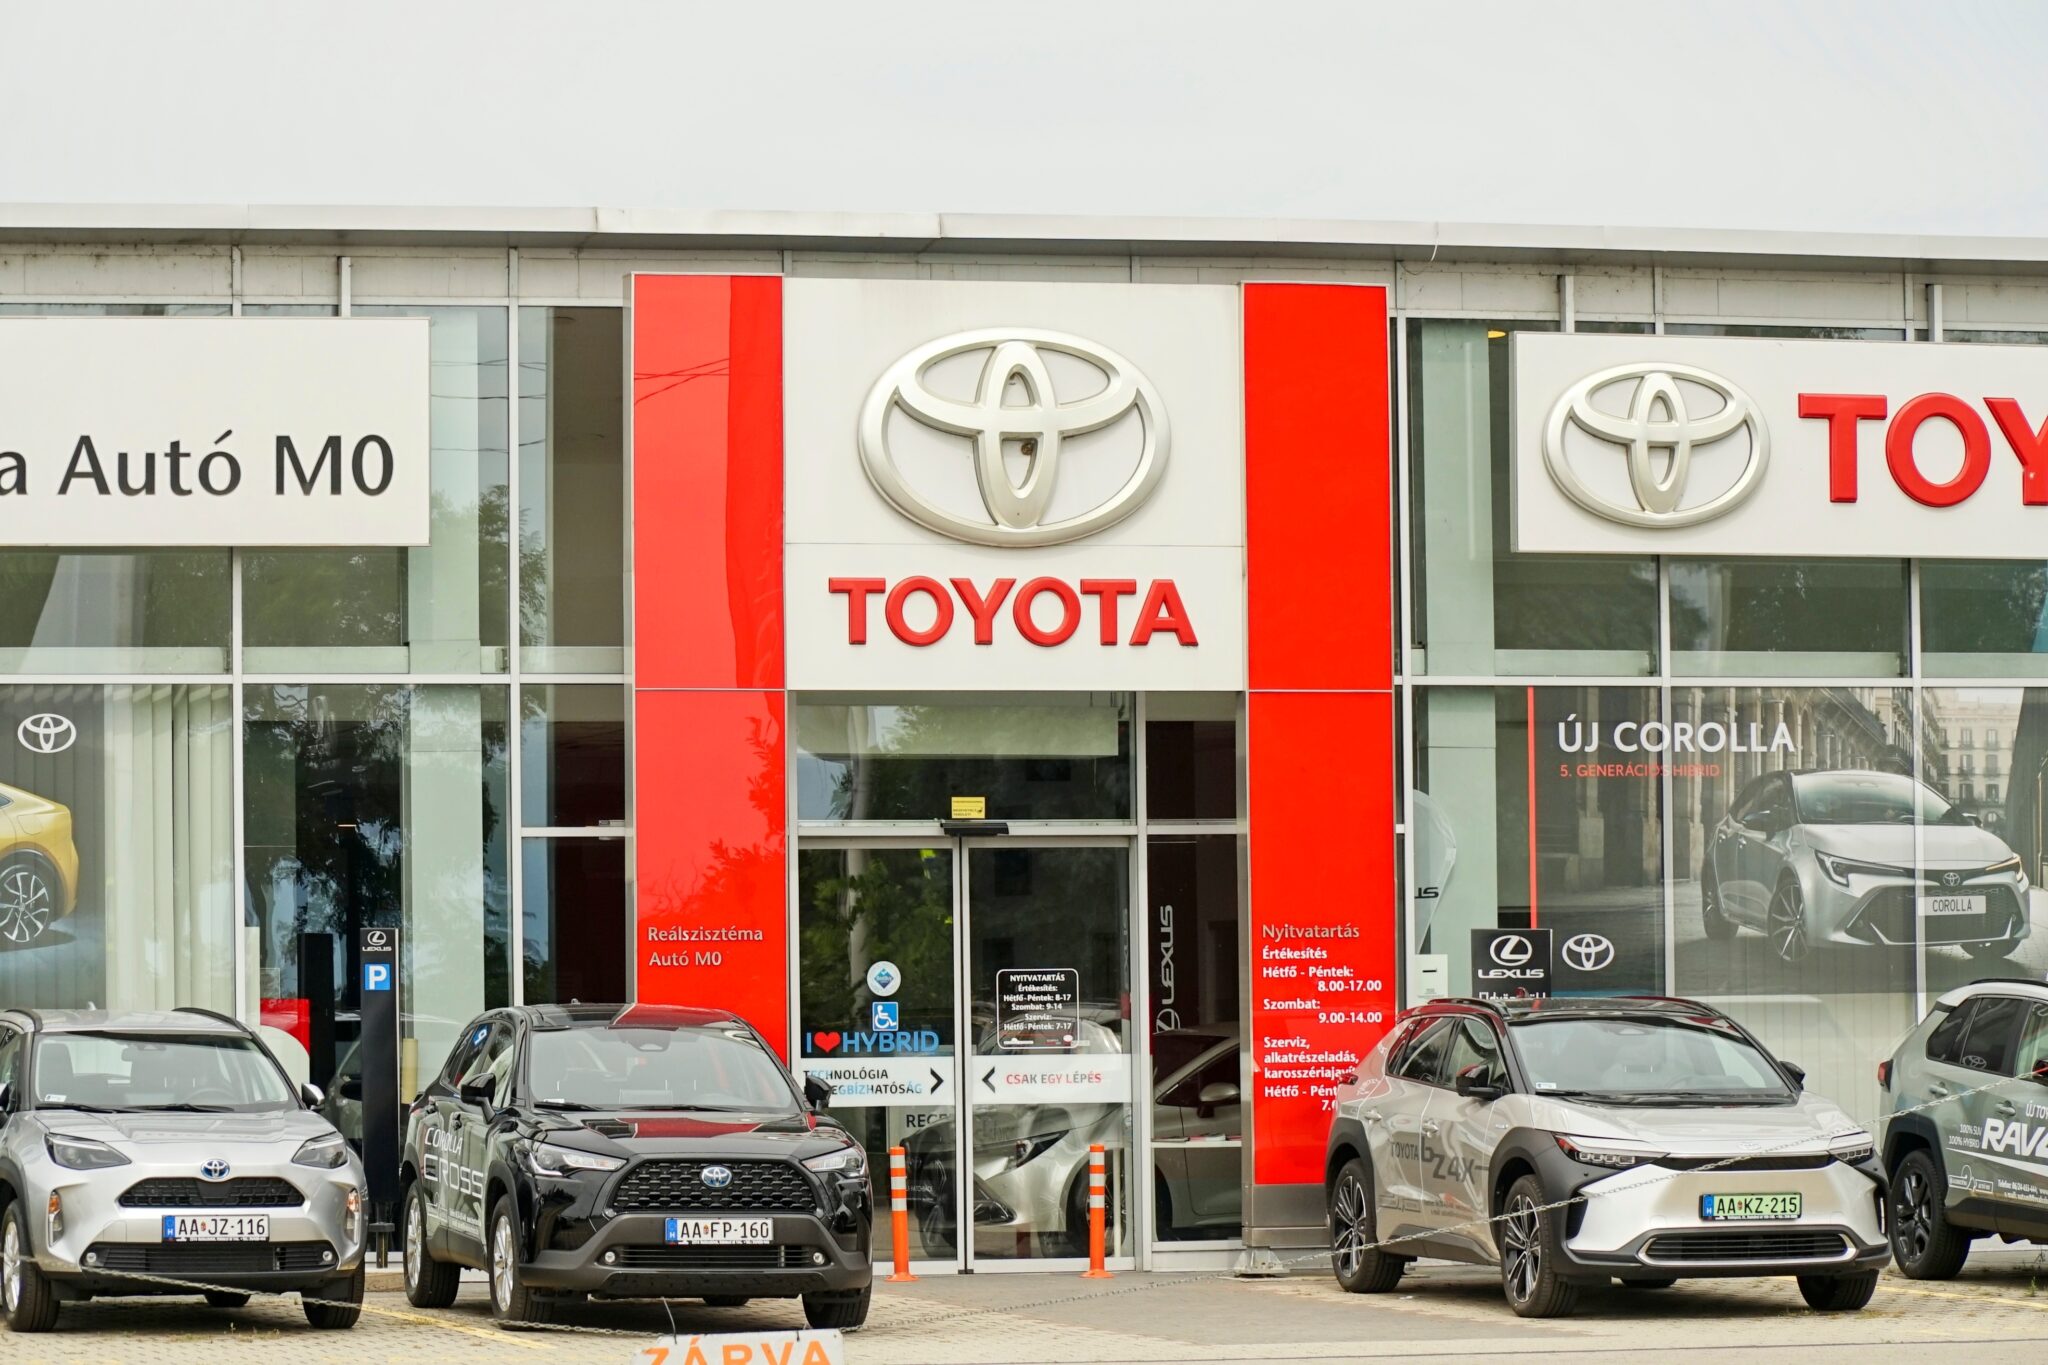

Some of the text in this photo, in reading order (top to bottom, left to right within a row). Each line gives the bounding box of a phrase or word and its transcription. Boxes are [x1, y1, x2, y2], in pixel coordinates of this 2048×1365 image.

[1798, 392, 2048, 507] TOY
[57, 429, 241, 496] Autó
[275, 434, 394, 496] M0
[828, 575, 1199, 647] TOYOTA
[1558, 713, 1796, 752] ÚJ COROLLA
[1560, 766, 1573, 777] 5.
[1673, 764, 1721, 777] HIBRID
[1932, 898, 1973, 912] COROLLA
[648, 925, 763, 941] Reálszisztéma
[1262, 923, 1360, 942] Nyitvatartás
[649, 950, 722, 966] Autó M0
[1160, 904, 1175, 1005] LEXUS
[1262, 945, 1327, 960] Értékesítés
[369, 965, 387, 990] P
[1010, 972, 1066, 982] NYITVATARTÁS
[1263, 965, 1297, 978] Hétfő
[1308, 965, 1354, 978] Péntek:
[1477, 968, 1545, 979] LEXUS
[1317, 980, 1383, 991] 8.00-17.00
[1263, 998, 1320, 1010] Szombat:
[1318, 1012, 1383, 1024] 9.00-14.00
[842, 1030, 940, 1053] HYBRID
[1263, 1036, 1311, 1050] Szerviz,
[1264, 1050, 1360, 1064] alkatrészeladás,
[1006, 1071, 1102, 1085] CSAK EGY LÉPÉS
[831, 1081, 922, 1095] EGBÍZHATÓSÁG
[1264, 1085, 1299, 1098] Hétfő
[425, 1127, 463, 1156] COROLLA
[1391, 1141, 1419, 1161] TOYOTA
[424, 1153, 484, 1201] CROSS
[1716, 1198, 1736, 1214] AA
[1744, 1197, 1797, 1213] KZ-215
[178, 1218, 199, 1236] AA
[208, 1218, 266, 1236] JZ-116
[680, 1222, 702, 1239] AA
[710, 1222, 769, 1239] FP-160
[641, 1335, 832, 1365] ZÁRVA
